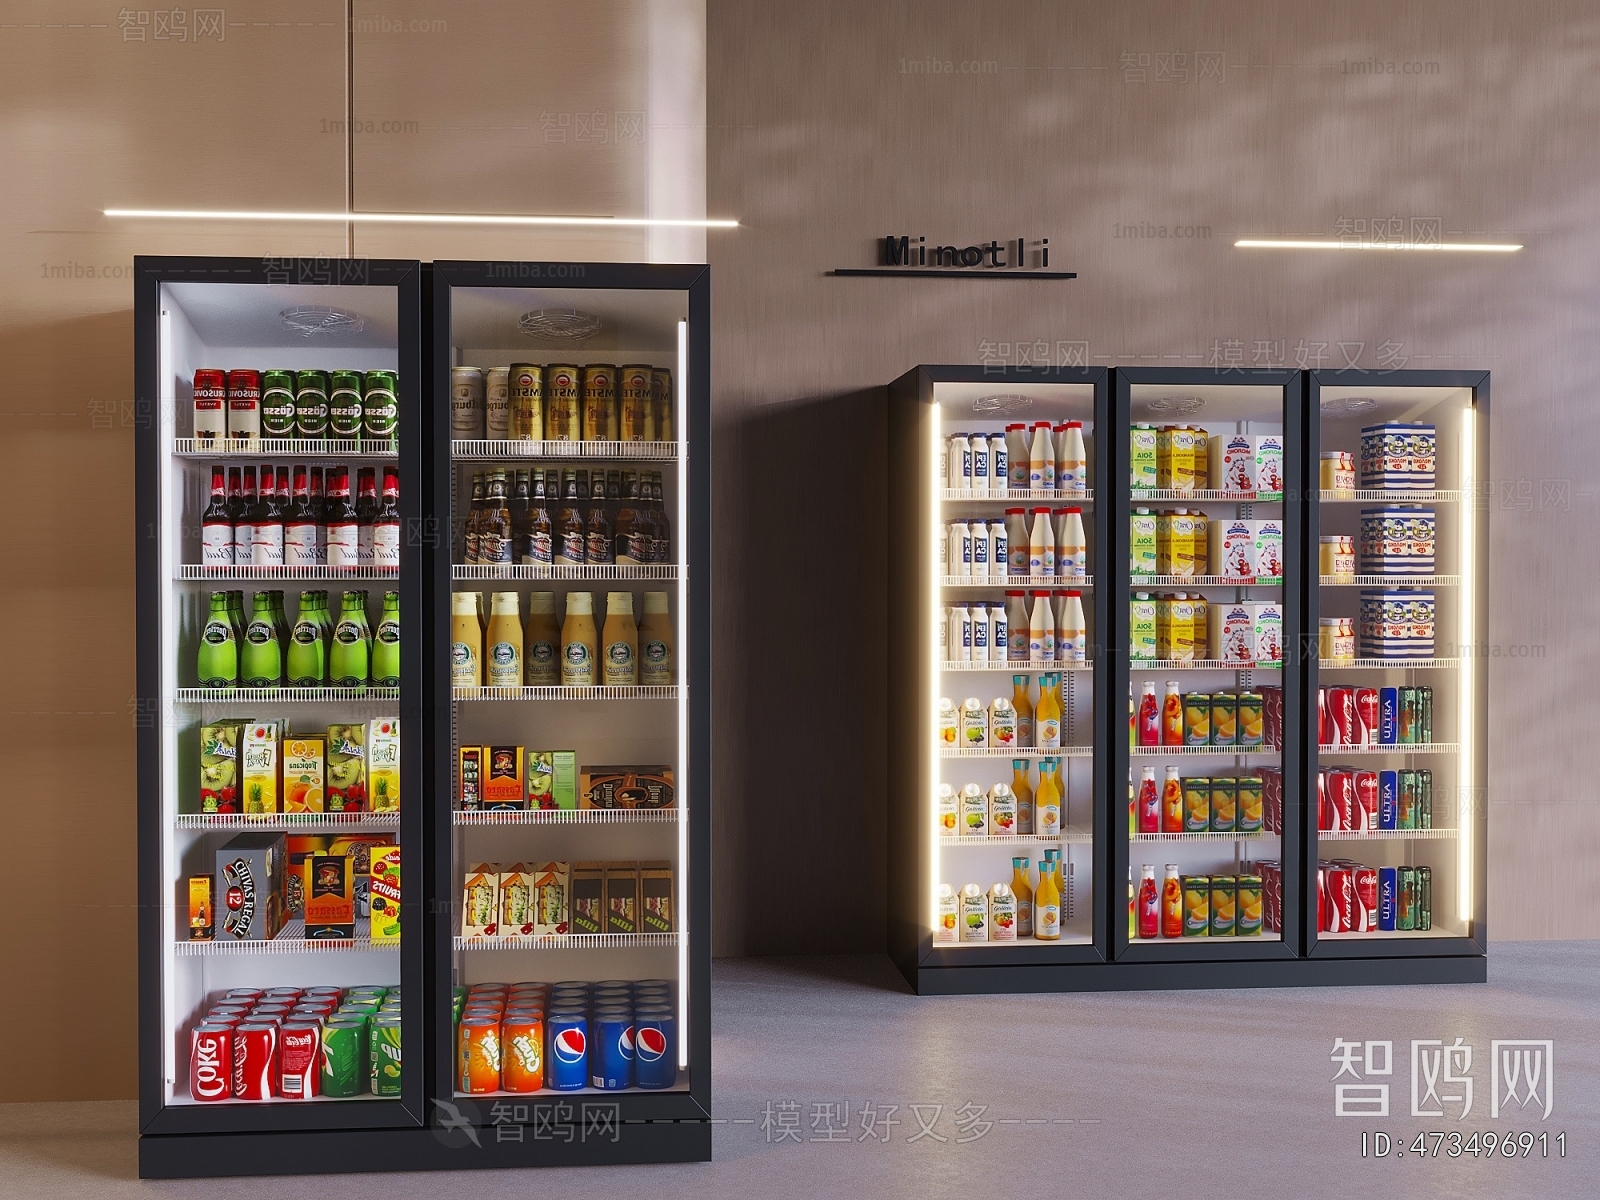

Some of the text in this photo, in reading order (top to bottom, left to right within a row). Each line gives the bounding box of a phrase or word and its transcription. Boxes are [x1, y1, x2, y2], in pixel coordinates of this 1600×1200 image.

[886, 236, 1048, 268] Minotli
[1383, 699, 1391, 738] ULTRA
[1383, 783, 1391, 822] ULTRA
[228, 891, 242, 906] 12
[234, 861, 255, 937] CHIVAS REGAL
[1383, 880, 1391, 920] ULTRA
